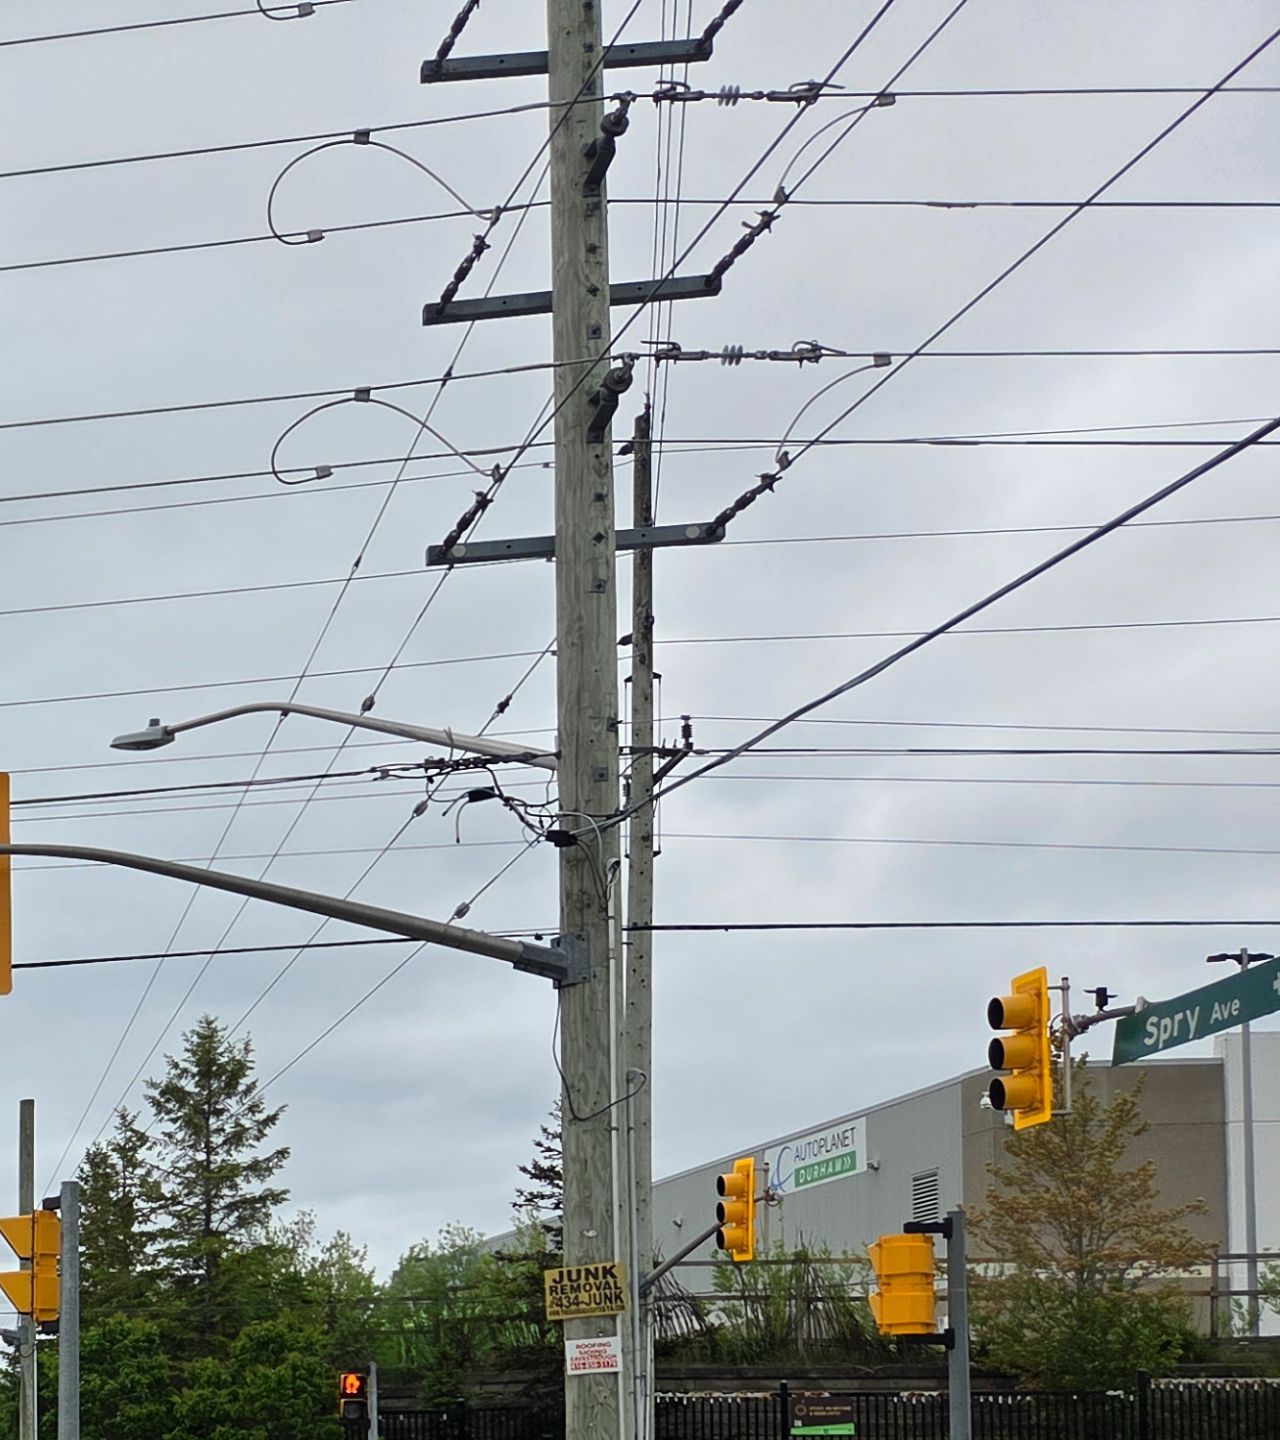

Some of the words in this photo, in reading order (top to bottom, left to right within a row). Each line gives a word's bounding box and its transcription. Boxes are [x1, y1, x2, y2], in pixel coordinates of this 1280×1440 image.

[1143, 1006, 1200, 1049] Spry
[1210, 998, 1240, 1025] Ave
[794, 1126, 856, 1163] AUTOPLANET
[799, 1156, 842, 1184] DURHAM
[549, 1280, 622, 1297] REMOVAL
[552, 1264, 618, 1285] JUNK
